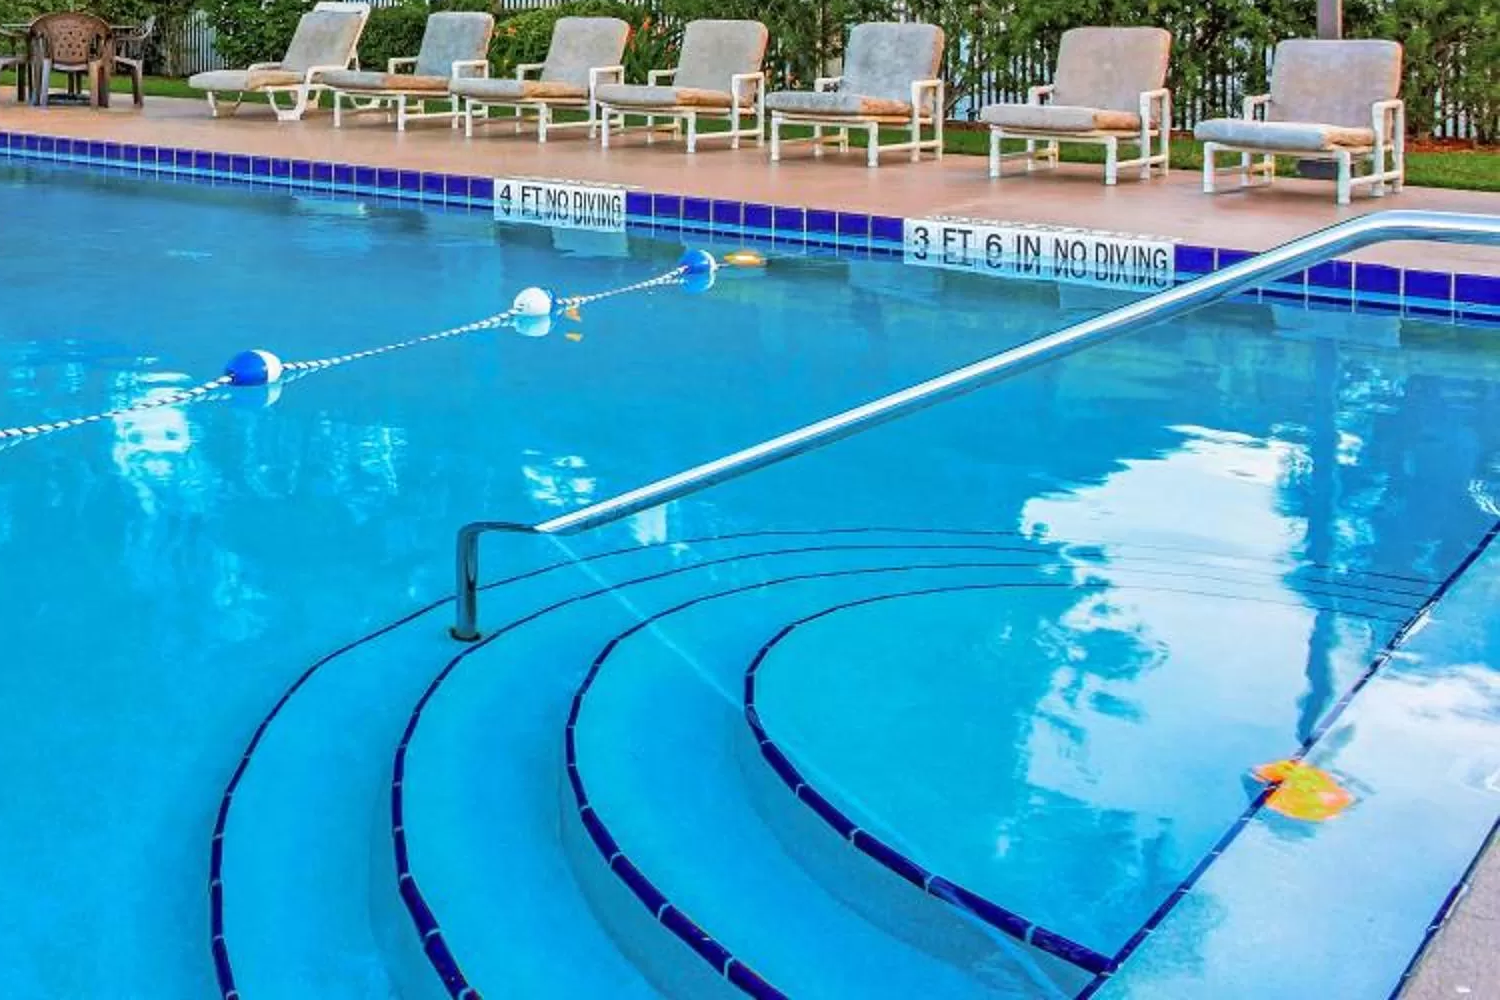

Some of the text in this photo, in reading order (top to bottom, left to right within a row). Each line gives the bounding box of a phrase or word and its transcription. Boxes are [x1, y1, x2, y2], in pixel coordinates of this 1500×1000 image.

[521, 185, 543, 209] FT
[546, 188, 569, 212] NO
[573, 191, 621, 220] DIVING
[914, 226, 1167, 276] 3 FT 6 IN NO DIVING
